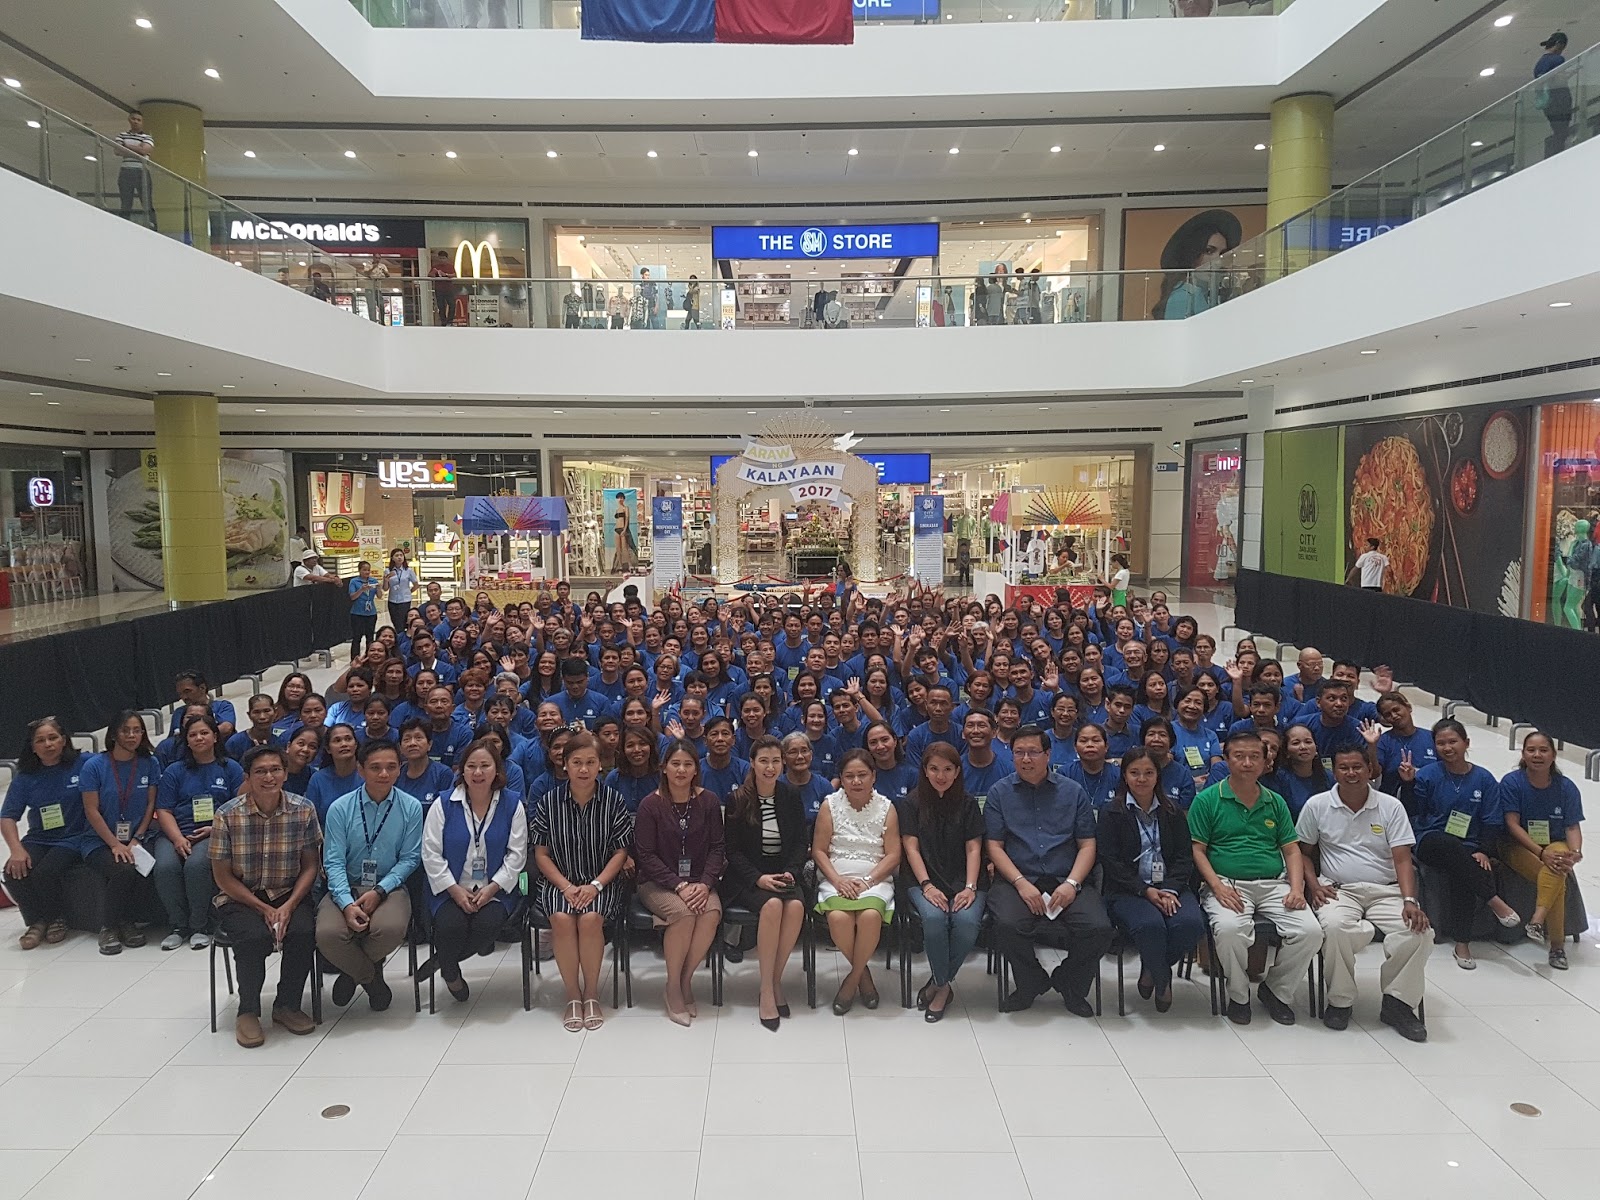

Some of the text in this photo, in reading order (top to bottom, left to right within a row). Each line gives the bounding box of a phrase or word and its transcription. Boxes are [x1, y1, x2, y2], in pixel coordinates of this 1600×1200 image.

[230, 220, 380, 242] McDonald's
[759, 230, 892, 254] THE SM STORE
[748, 446, 790, 460] ARAW
[379, 461, 429, 488] yes
[746, 465, 835, 482] KALAYAAN
[798, 485, 833, 498] 2017
[331, 522, 350, 531] 995
[1300, 533, 1316, 545] CITY
